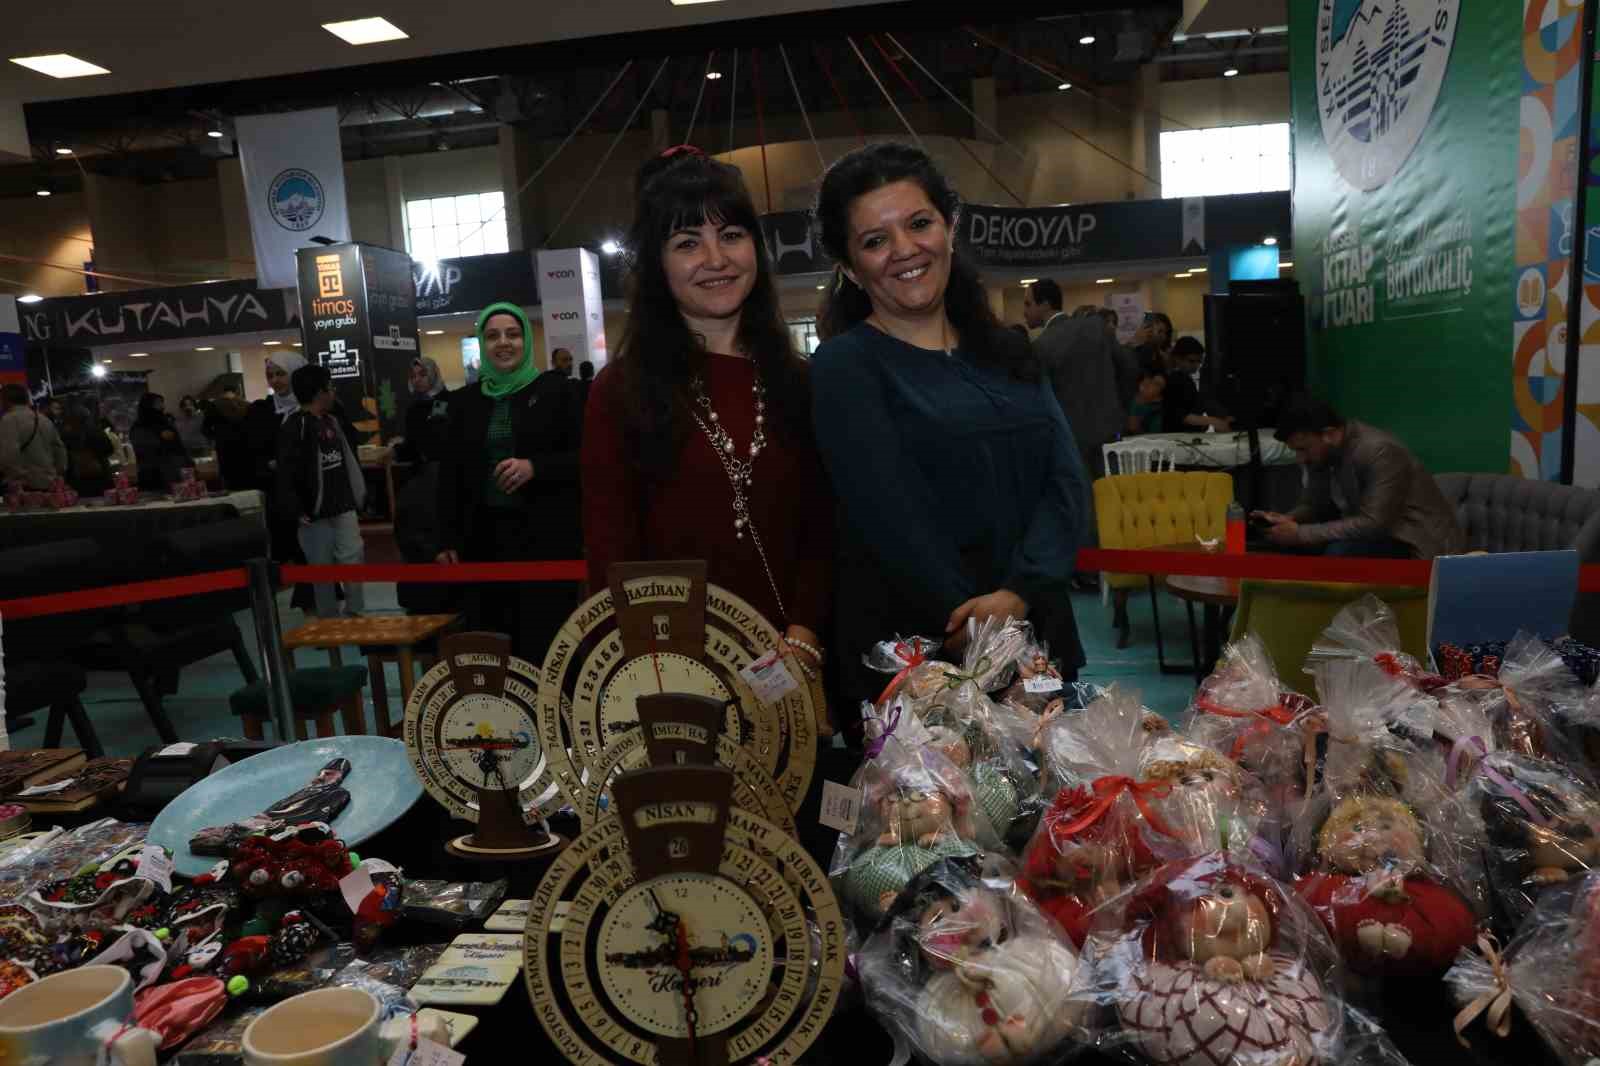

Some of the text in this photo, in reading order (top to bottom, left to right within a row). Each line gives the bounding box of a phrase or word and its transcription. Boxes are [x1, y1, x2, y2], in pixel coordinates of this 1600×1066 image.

[969, 213, 1097, 247] DEKOYAP
[645, 801, 697, 819] NİSAN
[571, 819, 620, 857] MAYIS
[530, 862, 567, 925] HAZİRAN
[778, 903, 798, 920] 20
[786, 926, 804, 940] 19
[824, 920, 838, 962] OCAK
[526, 933, 546, 1000] TEMMUZ
[565, 961, 580, 969] 3
[578, 999, 595, 1012] 5
[768, 1007, 784, 1021] 15
[797, 984, 832, 1036] ARALIK
[734, 1035, 751, 1051] 13
